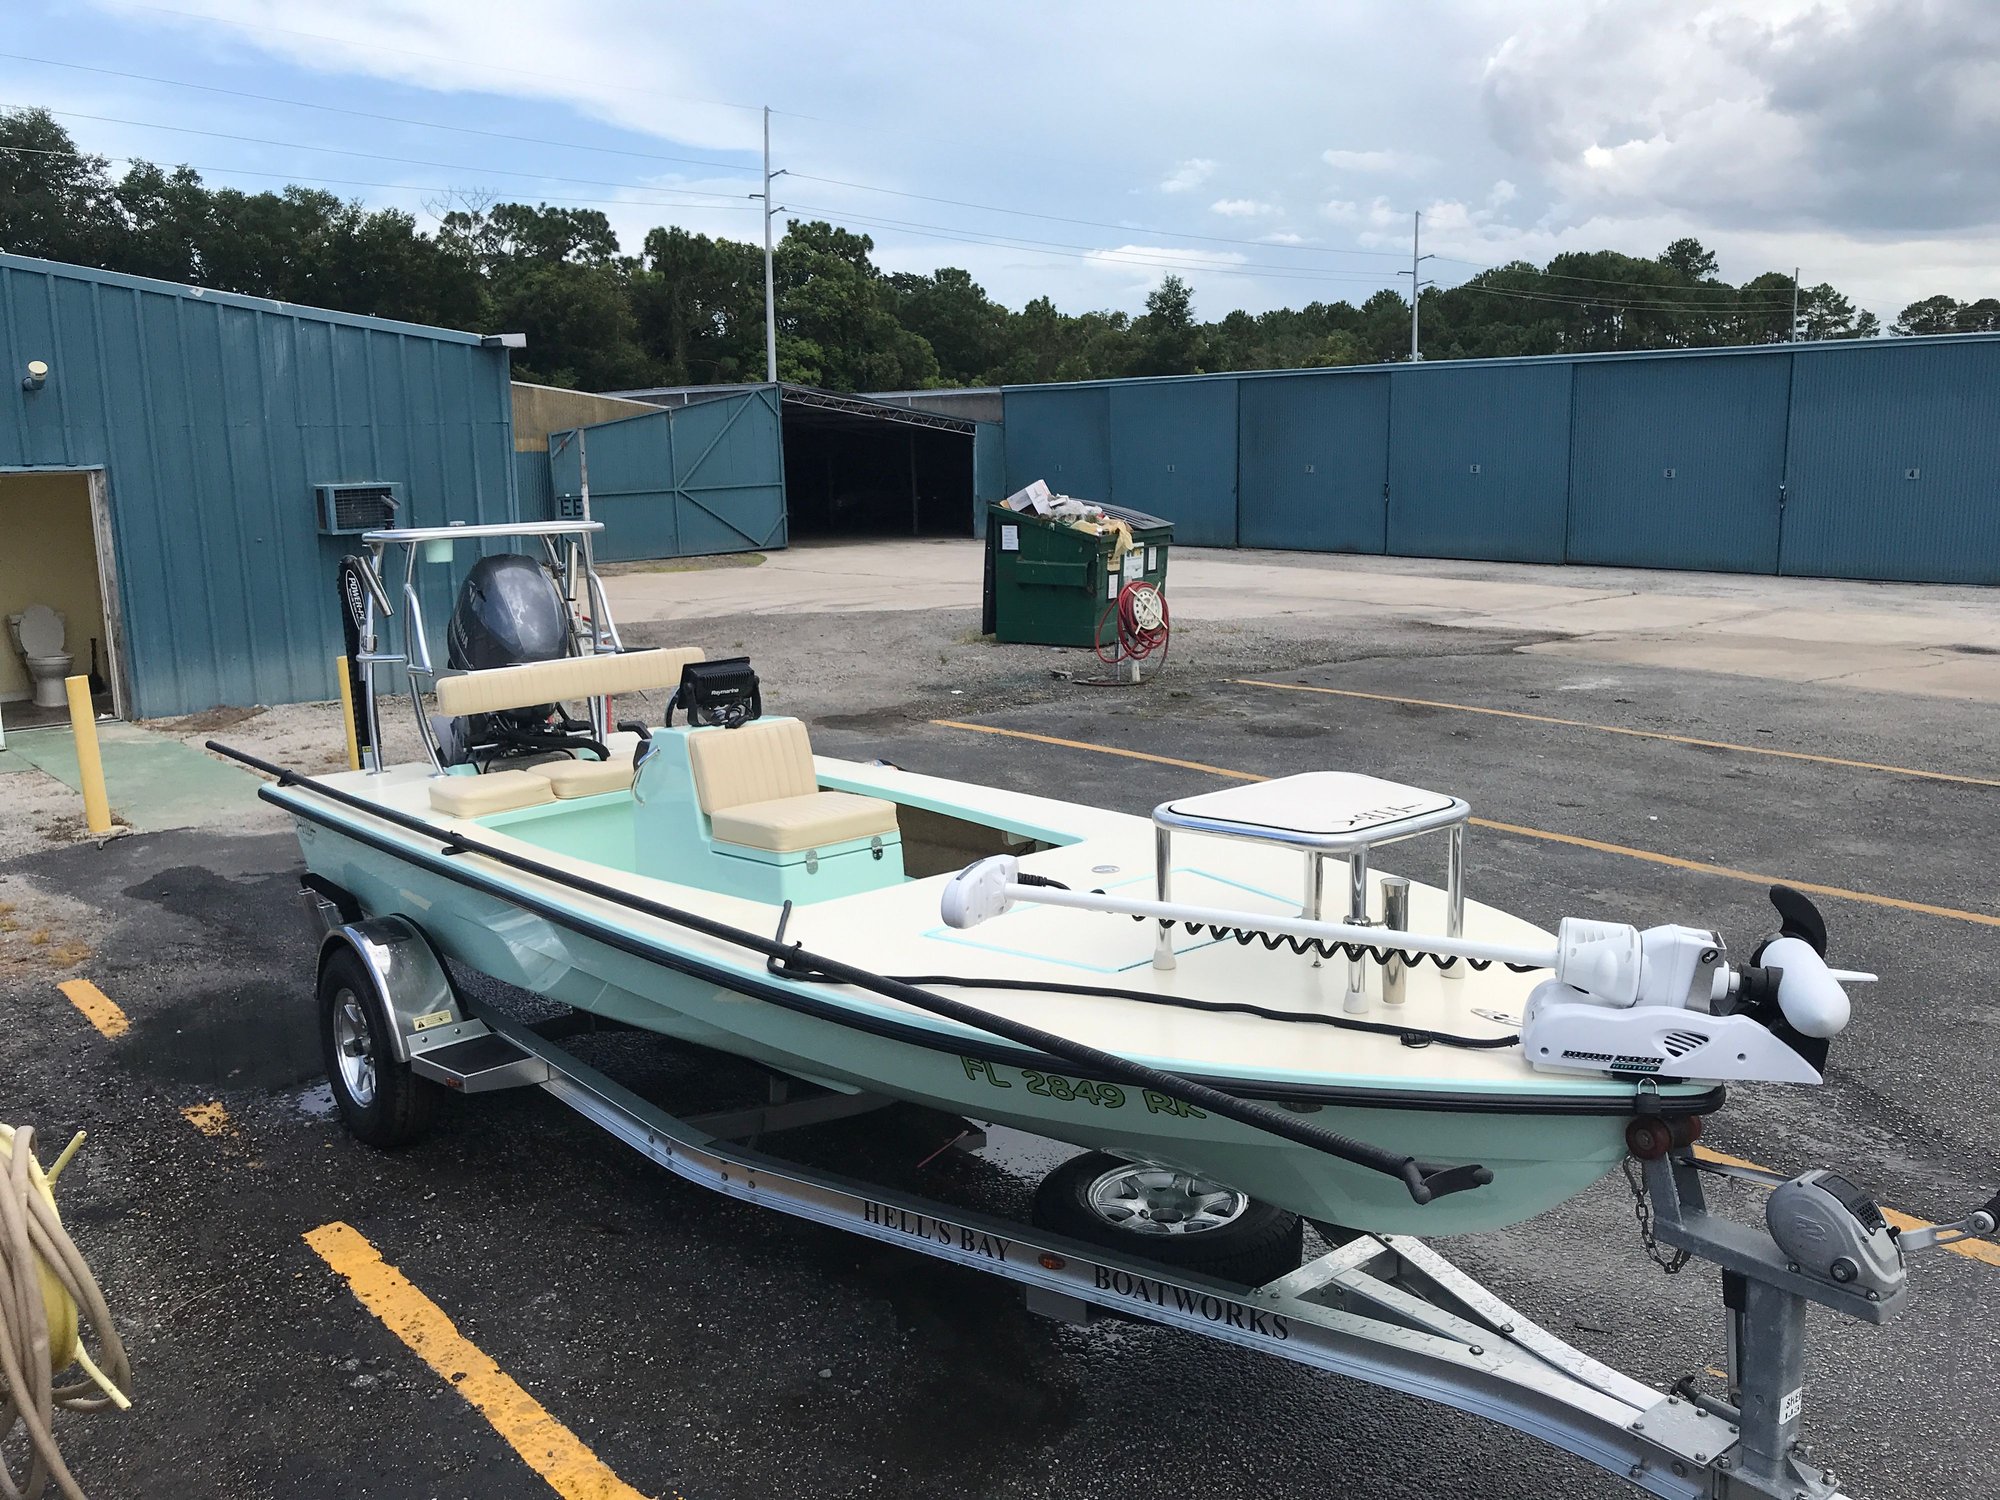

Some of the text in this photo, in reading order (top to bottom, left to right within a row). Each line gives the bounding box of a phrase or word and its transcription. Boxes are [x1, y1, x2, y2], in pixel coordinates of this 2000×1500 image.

[960, 1055, 1012, 1088] FL
[1021, 1069, 1126, 1109] 2849
[864, 1200, 1012, 1262] HELL'S BAY
[1094, 1265, 1288, 1340] BOATWORKS
